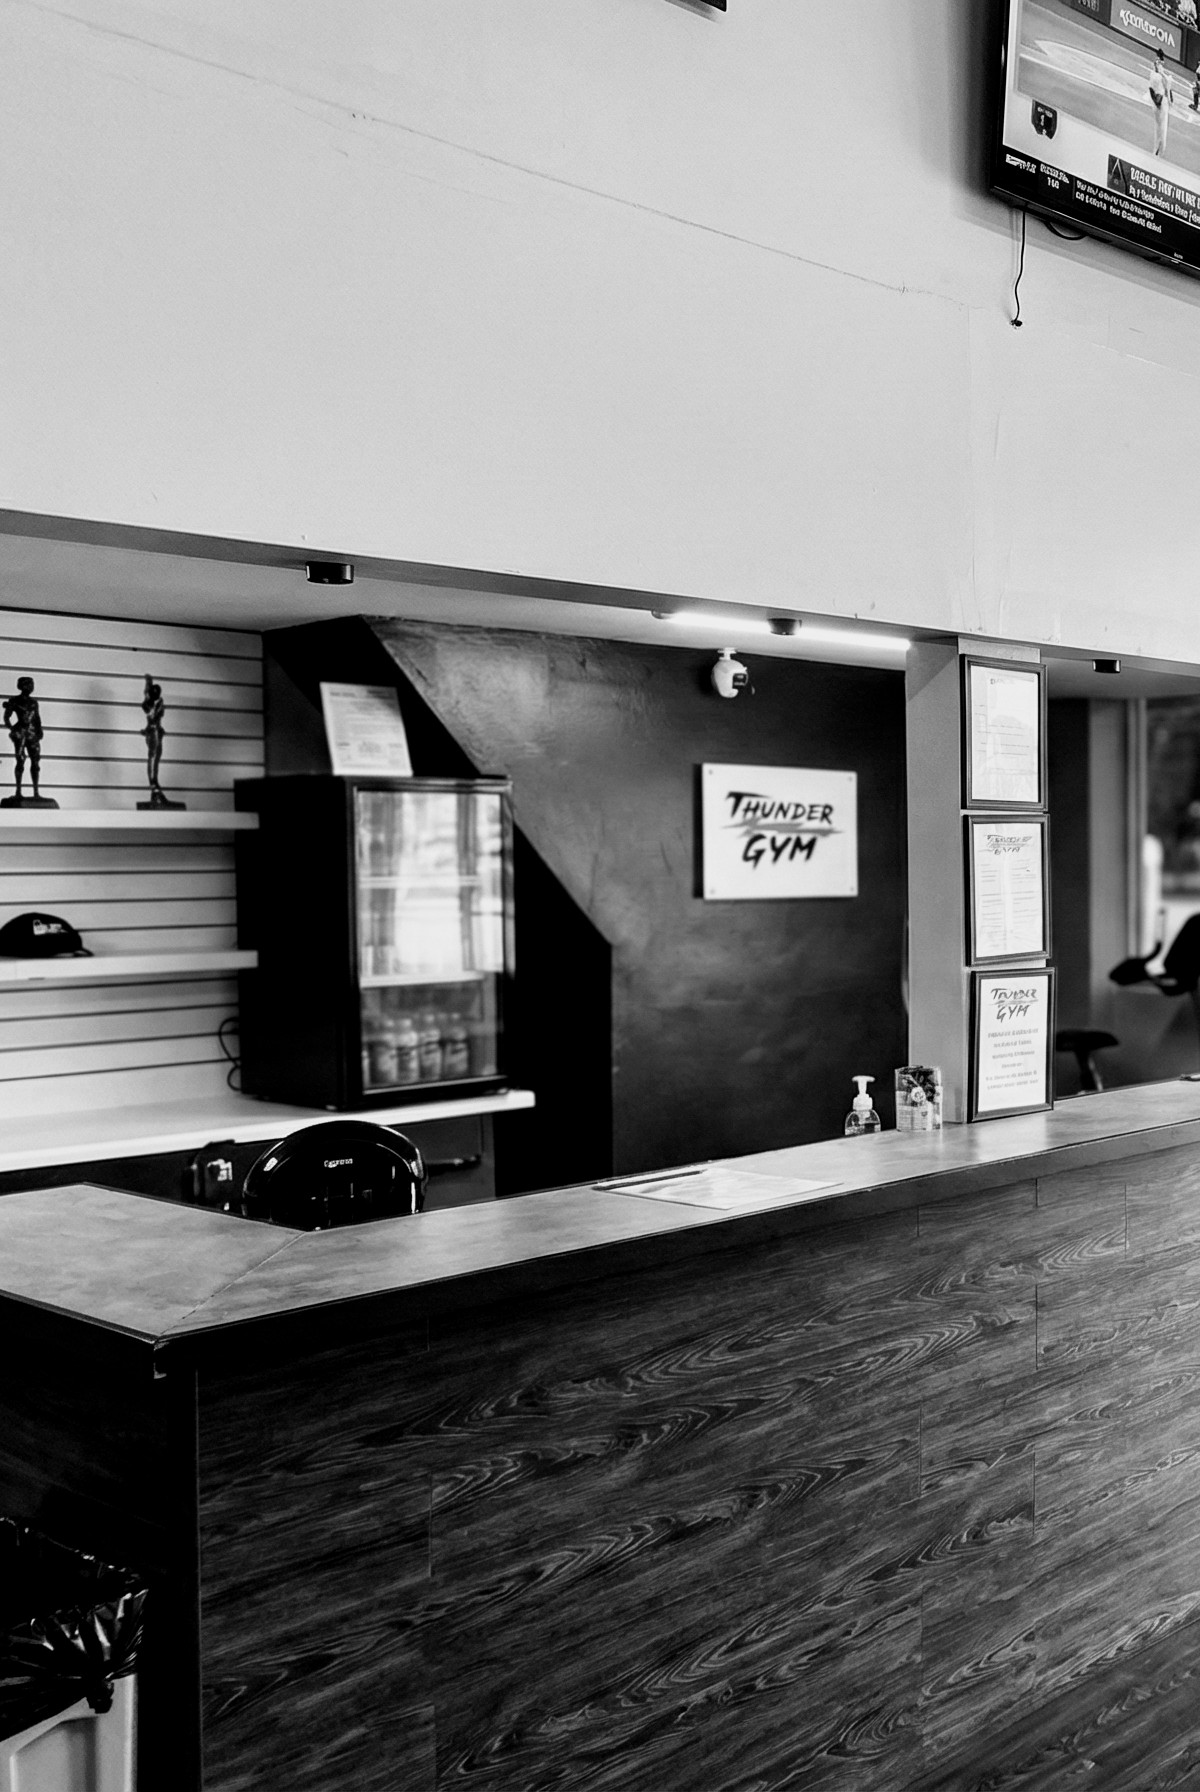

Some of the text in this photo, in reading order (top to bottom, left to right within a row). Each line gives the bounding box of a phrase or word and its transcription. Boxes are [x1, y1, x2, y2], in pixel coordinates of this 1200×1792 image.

[725, 791, 834, 825] THUNDER
[742, 833, 817, 870] GYM
[996, 1003, 1031, 1023] GYM
